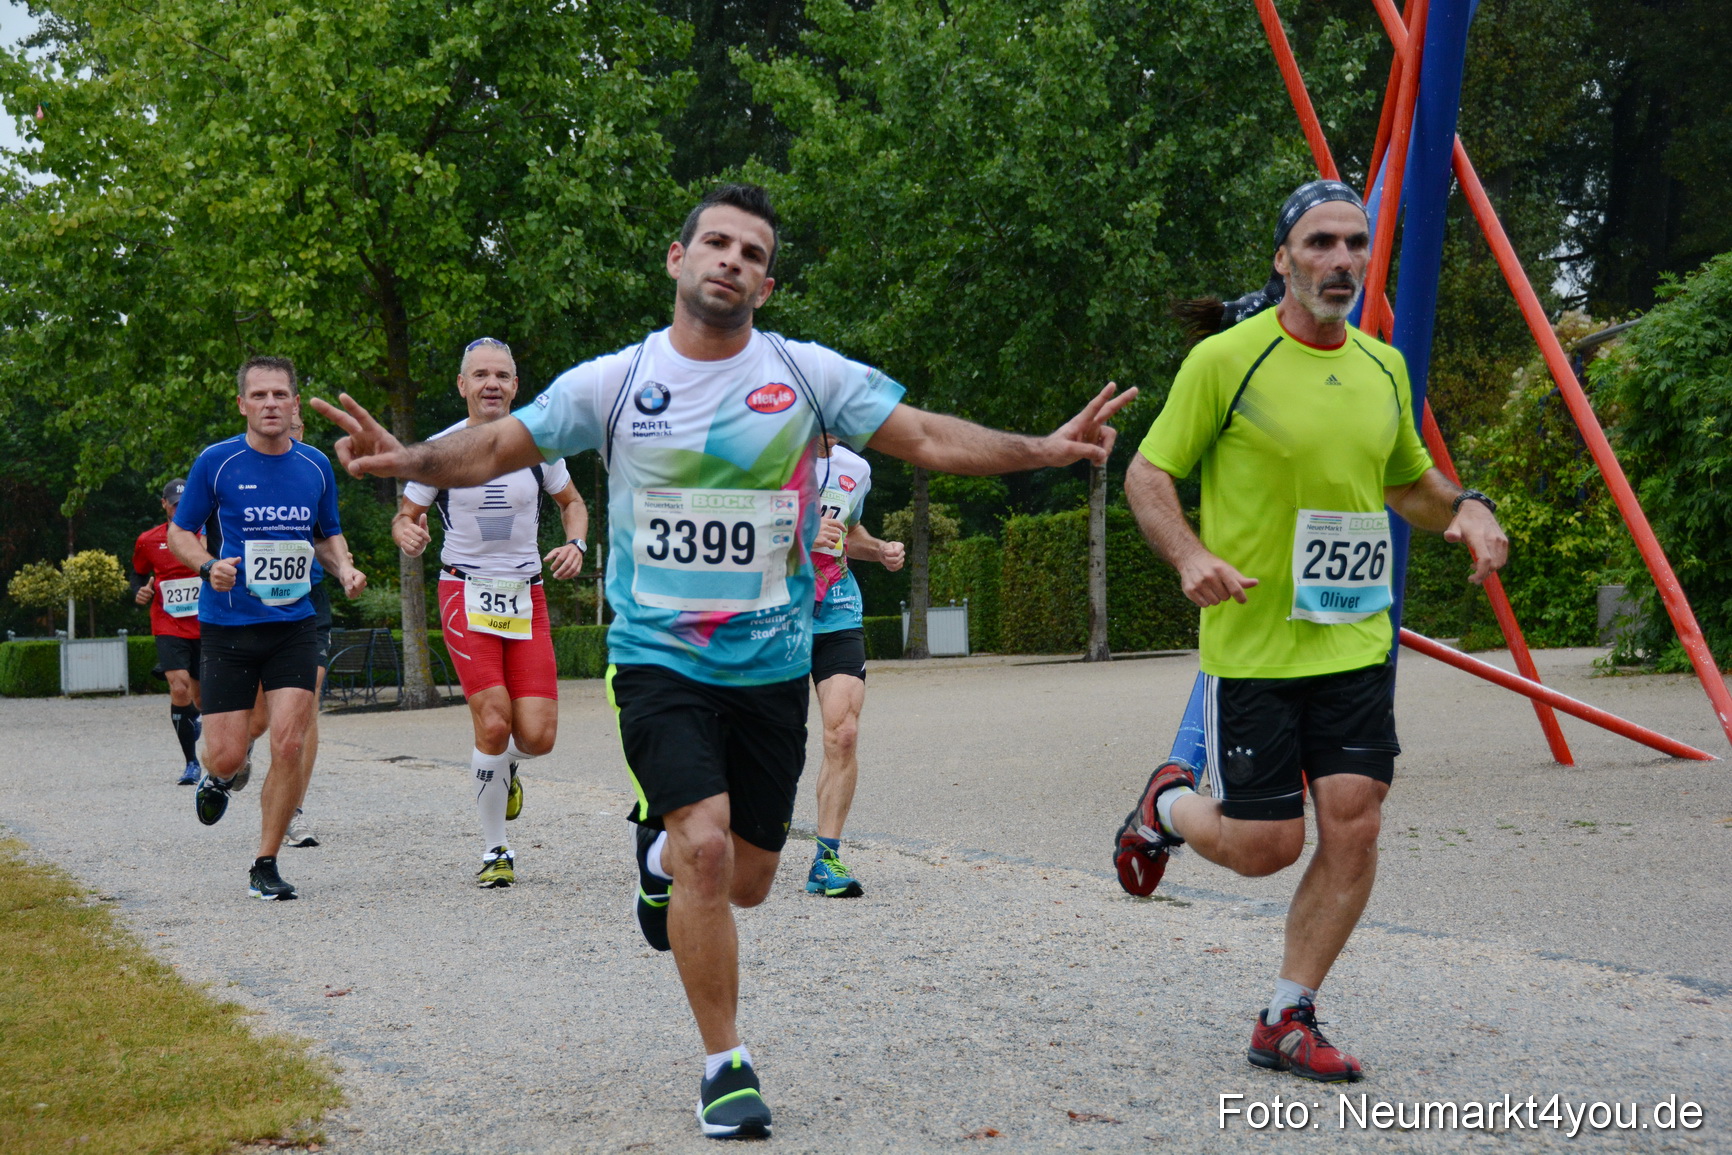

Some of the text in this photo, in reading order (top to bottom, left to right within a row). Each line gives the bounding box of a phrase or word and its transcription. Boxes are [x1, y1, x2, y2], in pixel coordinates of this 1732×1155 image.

[632, 421, 672, 430] PARTL
[632, 430, 672, 438] Neumarkt
[644, 501, 684, 510] NeuerMarkt
[691, 494, 756, 509] BOCK
[243, 505, 311, 522] SYSCAD
[1306, 523, 1343, 533] NeuerMarkt
[646, 518, 756, 566] 3399
[1302, 539, 1388, 581] 2526
[254, 556, 307, 581] 2568
[166, 586, 200, 603] 2372
[271, 587, 291, 597] Marc
[1319, 591, 1361, 609] Oliver
[479, 591, 519, 615] 351
[488, 618, 511, 630] Josef
